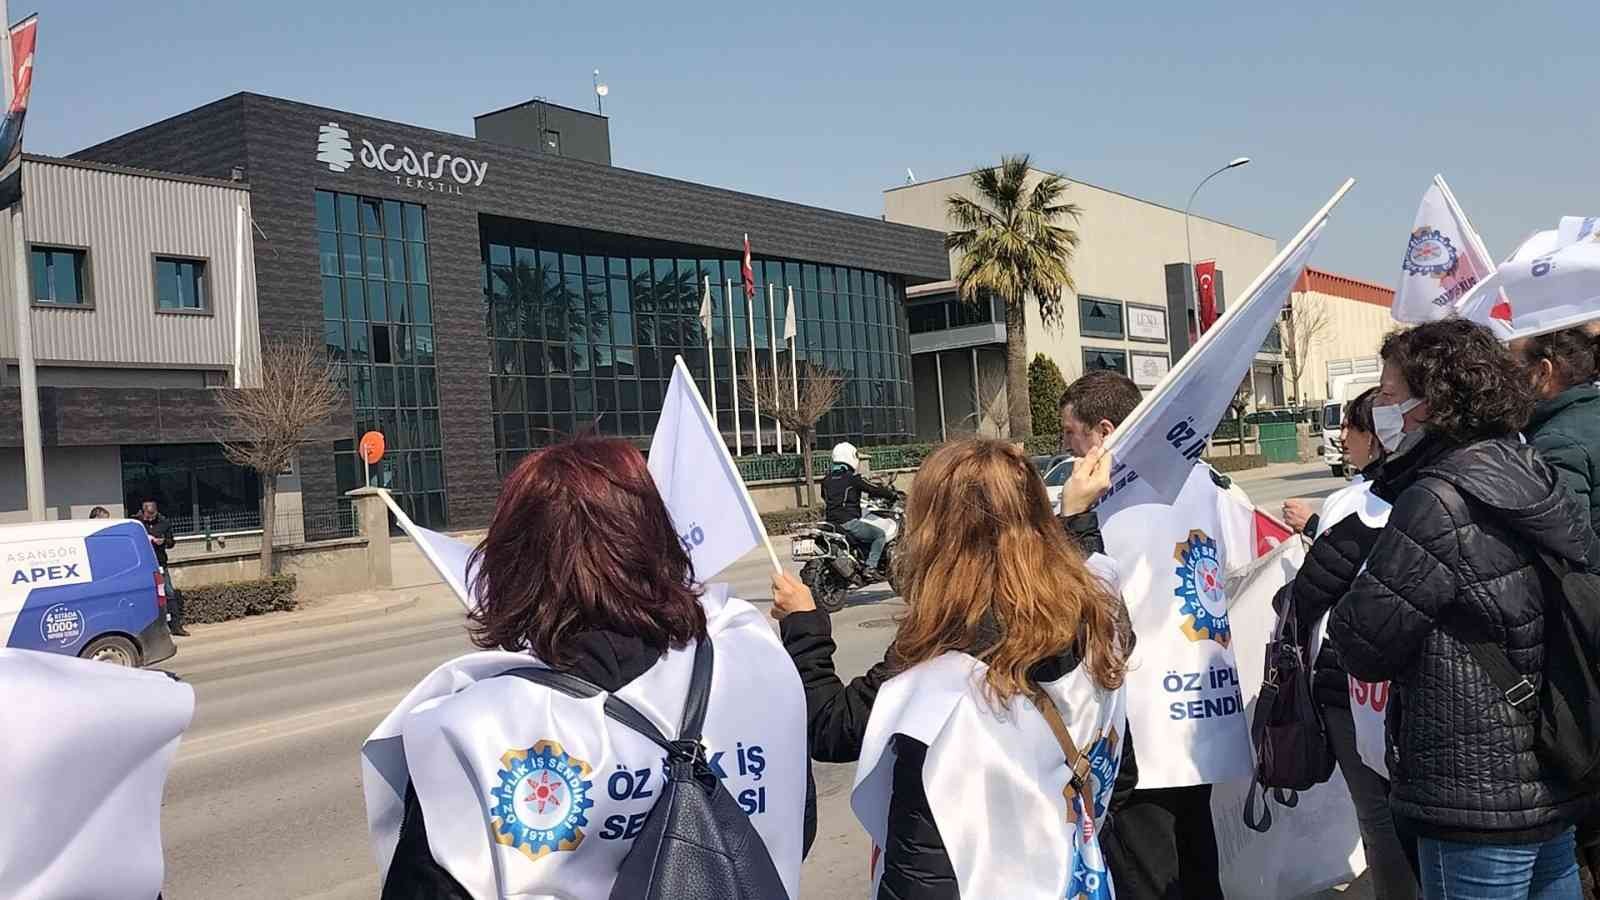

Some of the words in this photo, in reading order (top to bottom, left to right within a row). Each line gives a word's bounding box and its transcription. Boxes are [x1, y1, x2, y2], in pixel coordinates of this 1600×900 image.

[361, 139, 488, 186] acarsoy
[1166, 416, 1196, 448] ÖZ
[12, 563, 80, 584] APEX
[1163, 670, 1202, 693] ÖZ
[1209, 666, 1239, 689] İPL
[1169, 690, 1243, 720] SENDİ
[608, 764, 652, 801] ÖZ
[737, 742, 765, 781] İŞ
[521, 828, 554, 841] 1978
